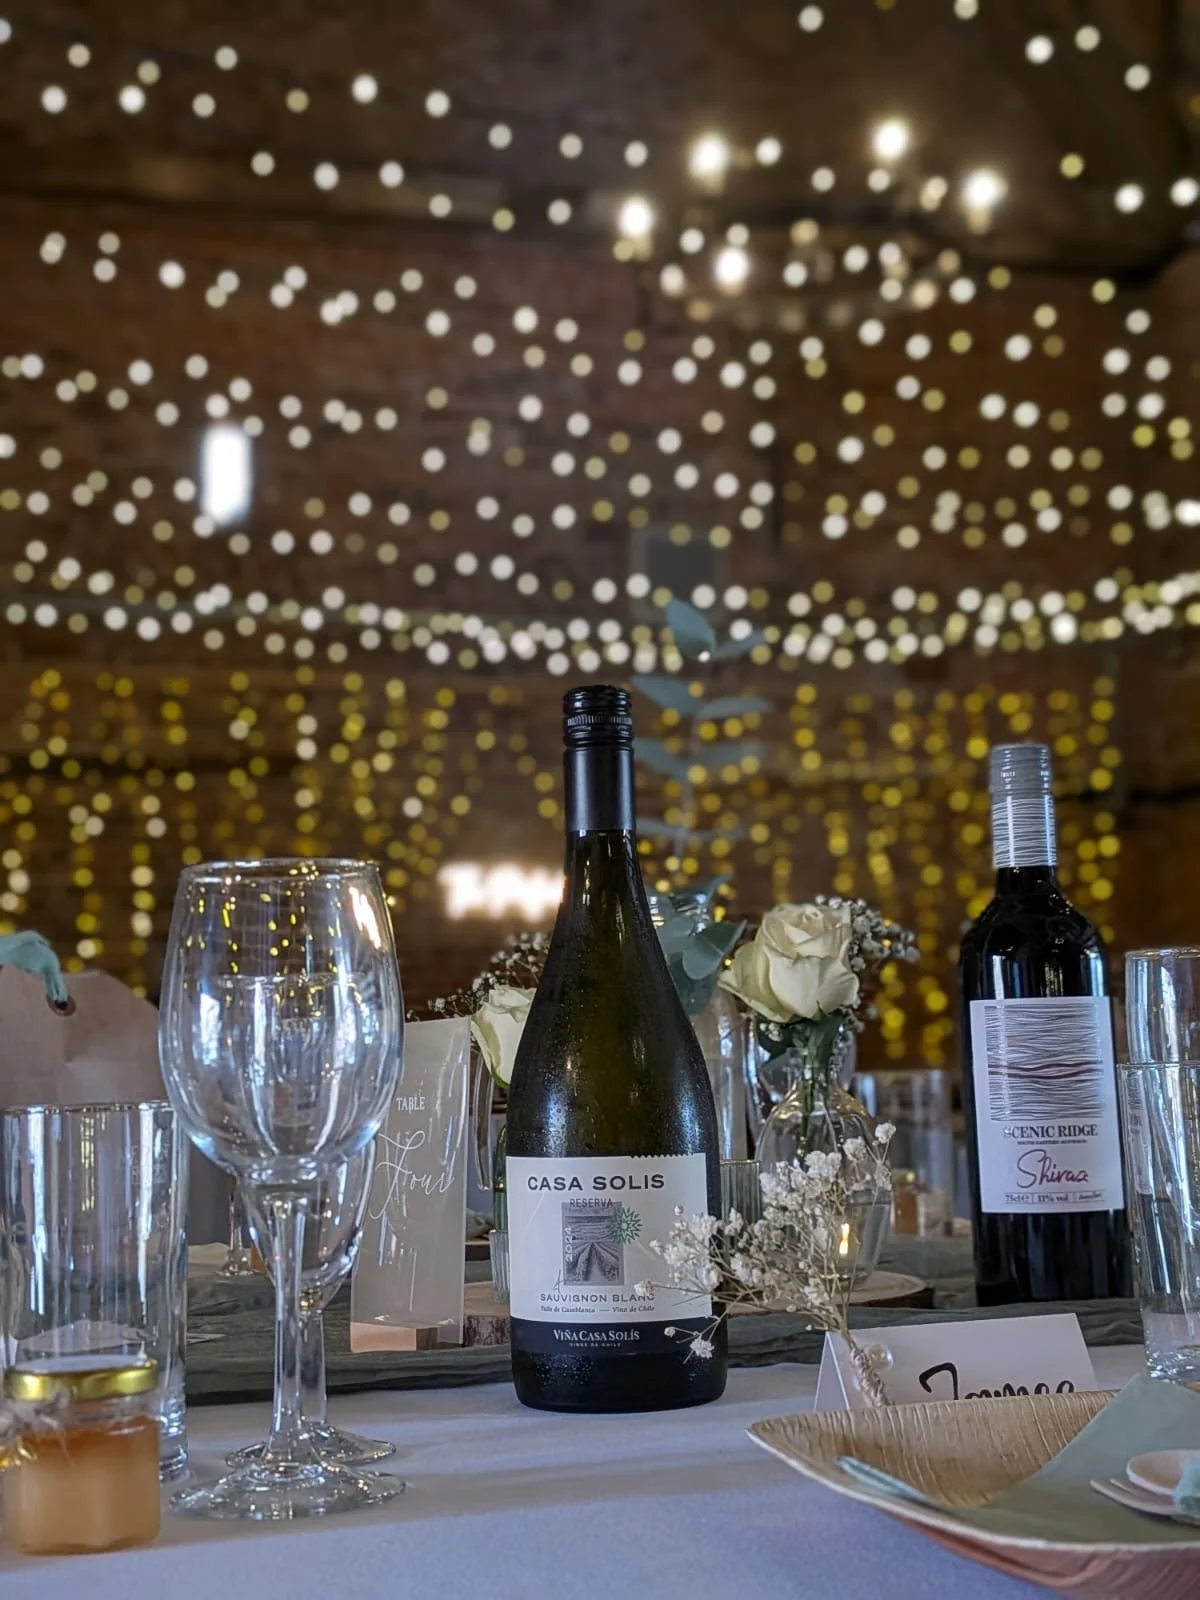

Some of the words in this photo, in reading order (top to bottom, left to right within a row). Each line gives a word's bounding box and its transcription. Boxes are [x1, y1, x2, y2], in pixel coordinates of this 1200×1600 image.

[396, 1096, 425, 1111] TABLE
[1003, 1124, 1055, 1138] SCENIC
[1058, 1123, 1098, 1137] RIDGE
[368, 1130, 455, 1220] Four
[1016, 1148, 1088, 1189] Shiraz
[527, 1175, 583, 1191] CASA
[592, 1173, 665, 1190] SOLIS
[569, 1197, 614, 1209] RESERVA
[564, 1227, 573, 1262] 2024
[539, 1292, 608, 1303] SAUVIGNON
[612, 1292, 655, 1303] BLANC
[579, 1329, 608, 1341] CASA
